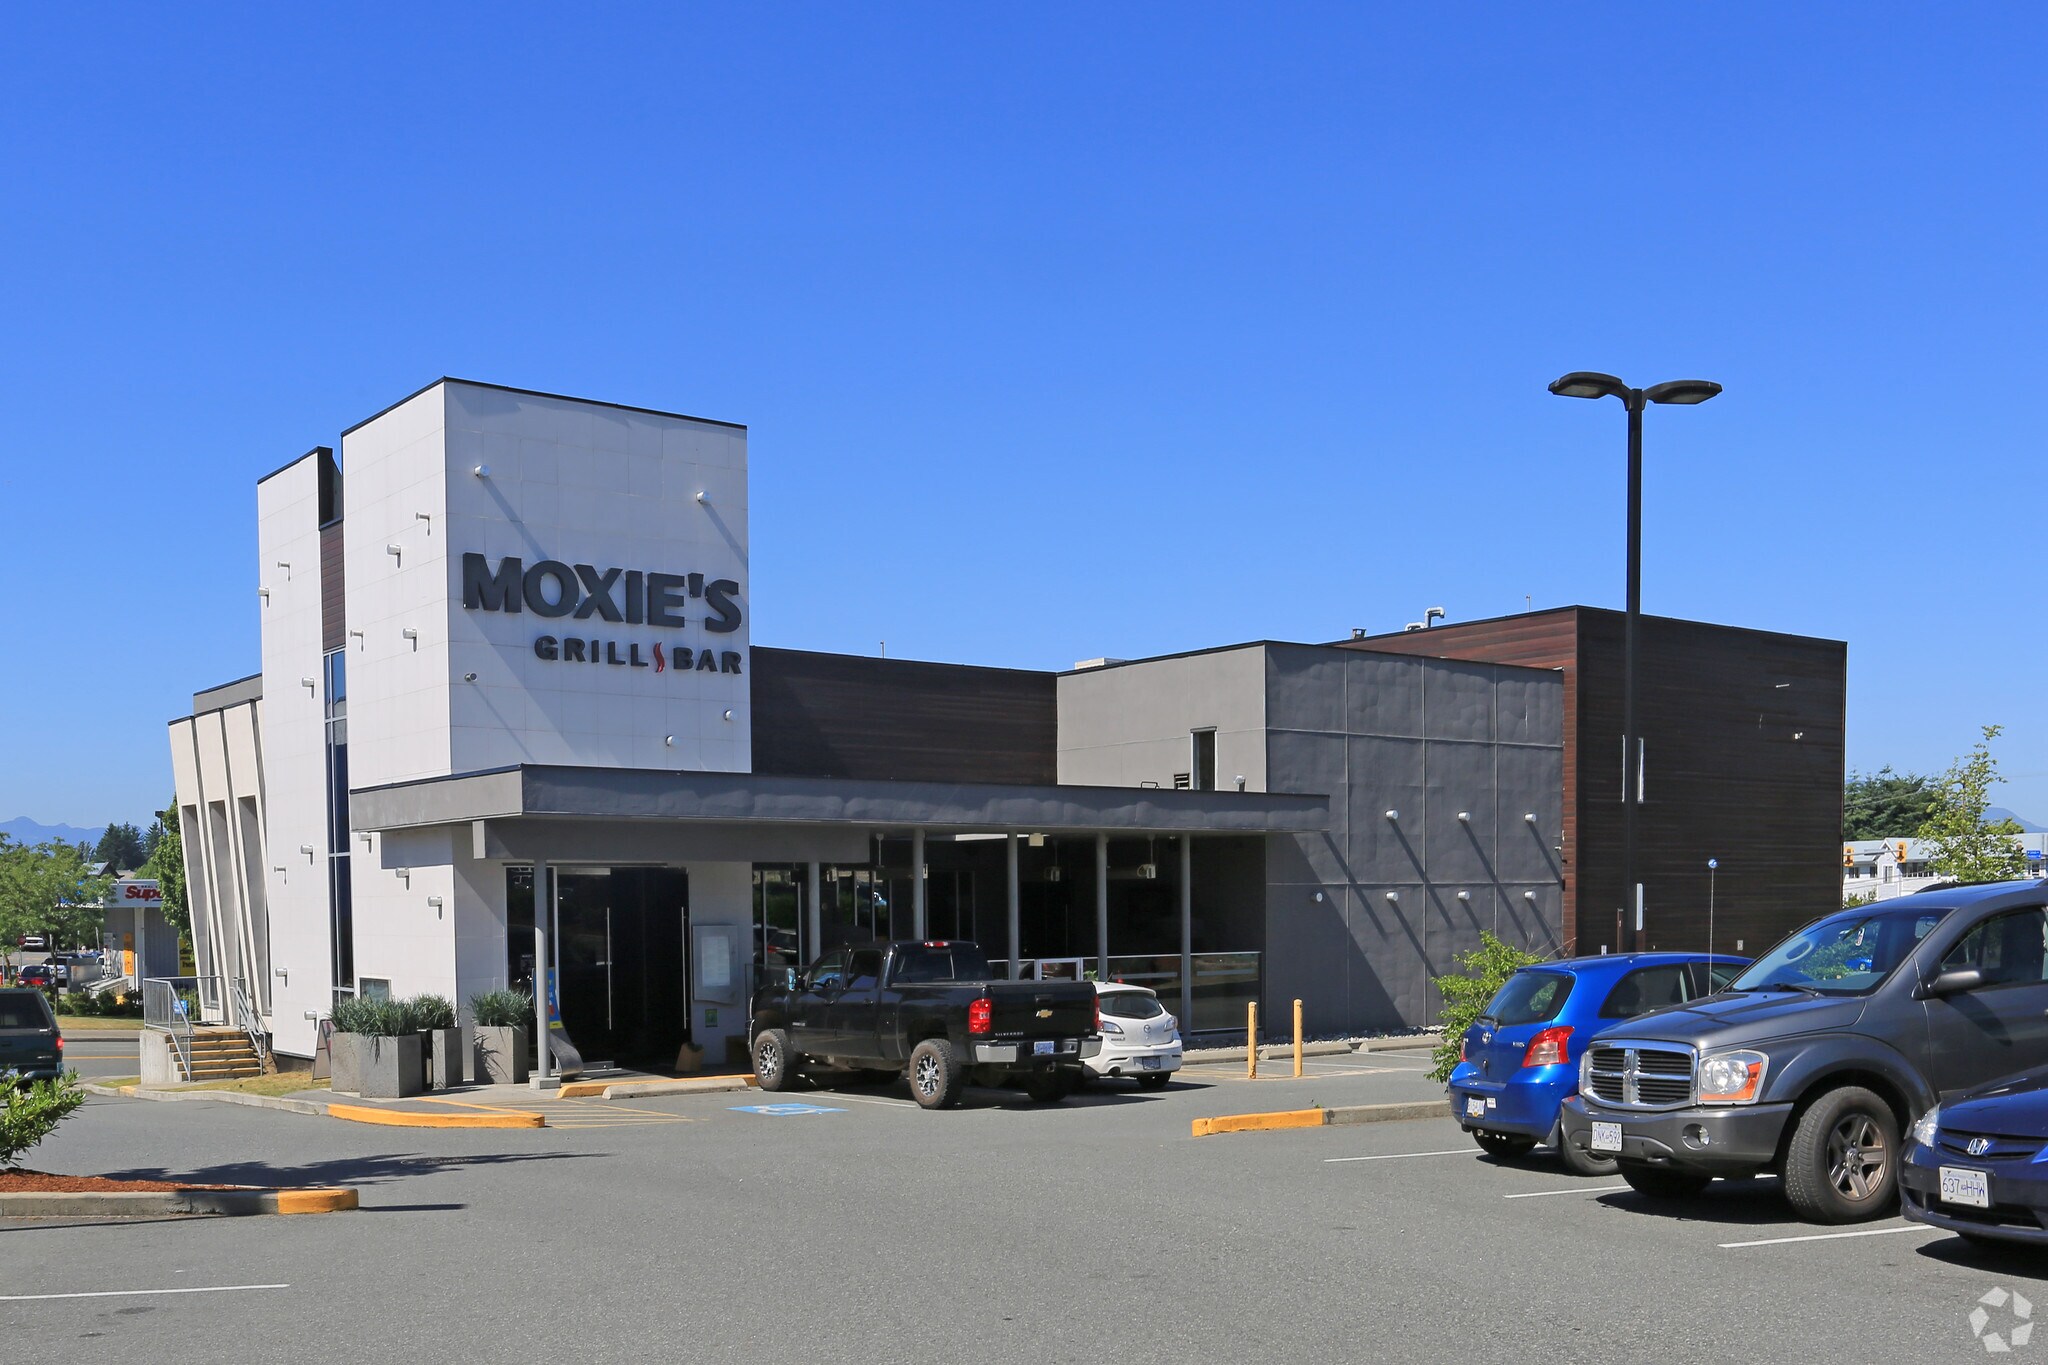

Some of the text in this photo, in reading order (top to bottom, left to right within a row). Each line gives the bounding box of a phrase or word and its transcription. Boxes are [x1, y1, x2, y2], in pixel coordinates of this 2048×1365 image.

[462, 552, 742, 633] MOXIE'S
[534, 635, 742, 674] GRILL BAR
[1942, 1177, 1960, 1194] 637
